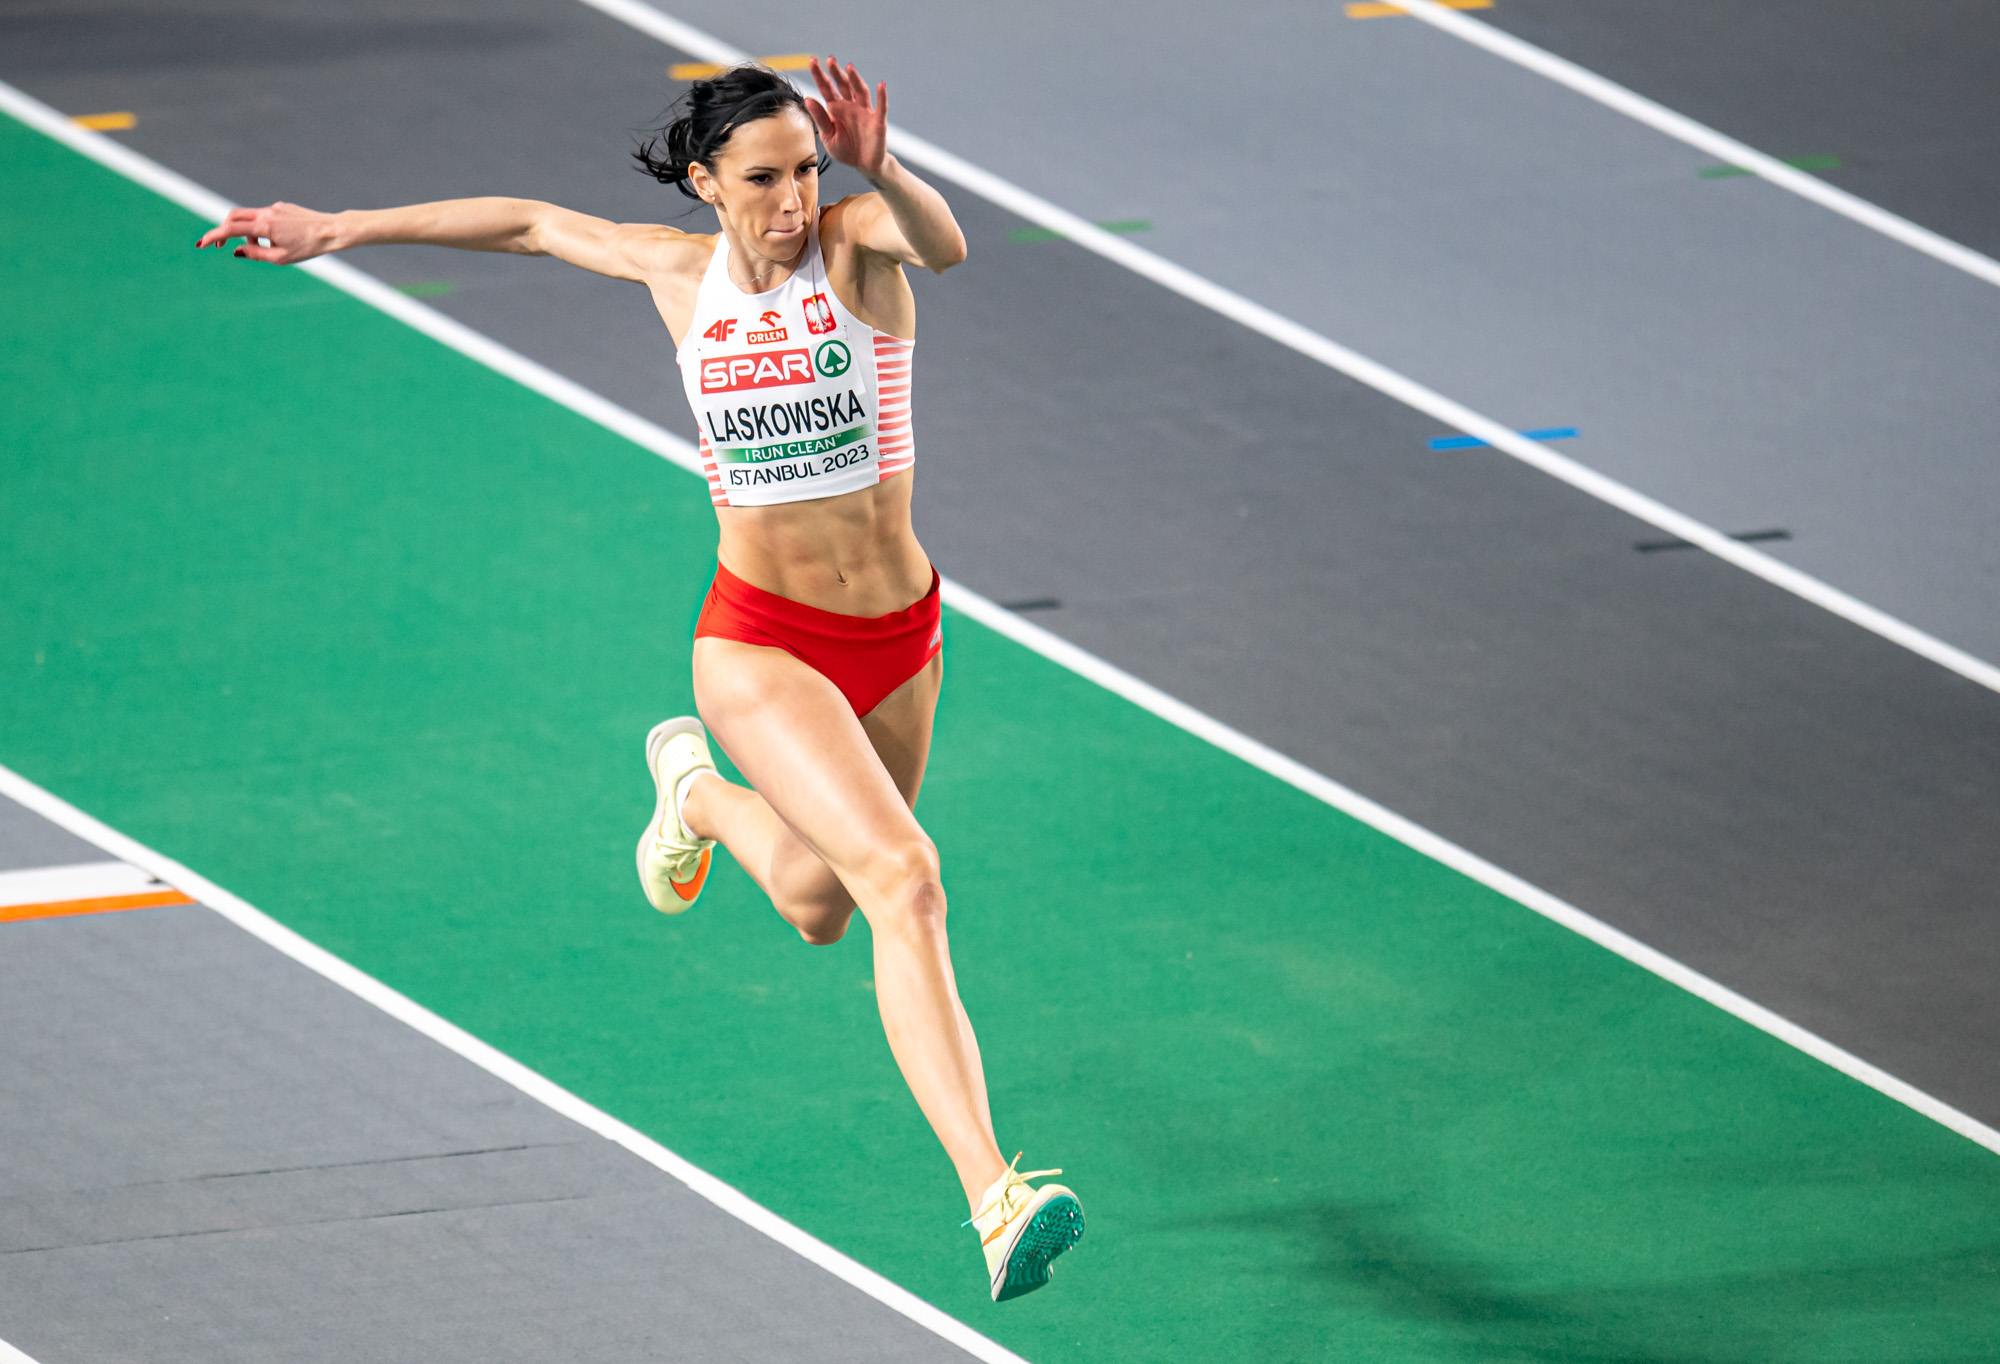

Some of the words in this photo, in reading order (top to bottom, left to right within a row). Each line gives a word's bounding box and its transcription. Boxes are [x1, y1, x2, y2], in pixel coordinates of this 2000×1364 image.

[703, 318, 738, 342] 4F
[748, 331, 786, 344] ORLEN
[703, 353, 811, 389] SPAR
[706, 389, 866, 443] LASKOWSKA
[729, 461, 820, 486] ISTANBUL
[823, 444, 870, 473] 2023
[745, 451, 750, 462] I
[753, 447, 784, 461] RUN
